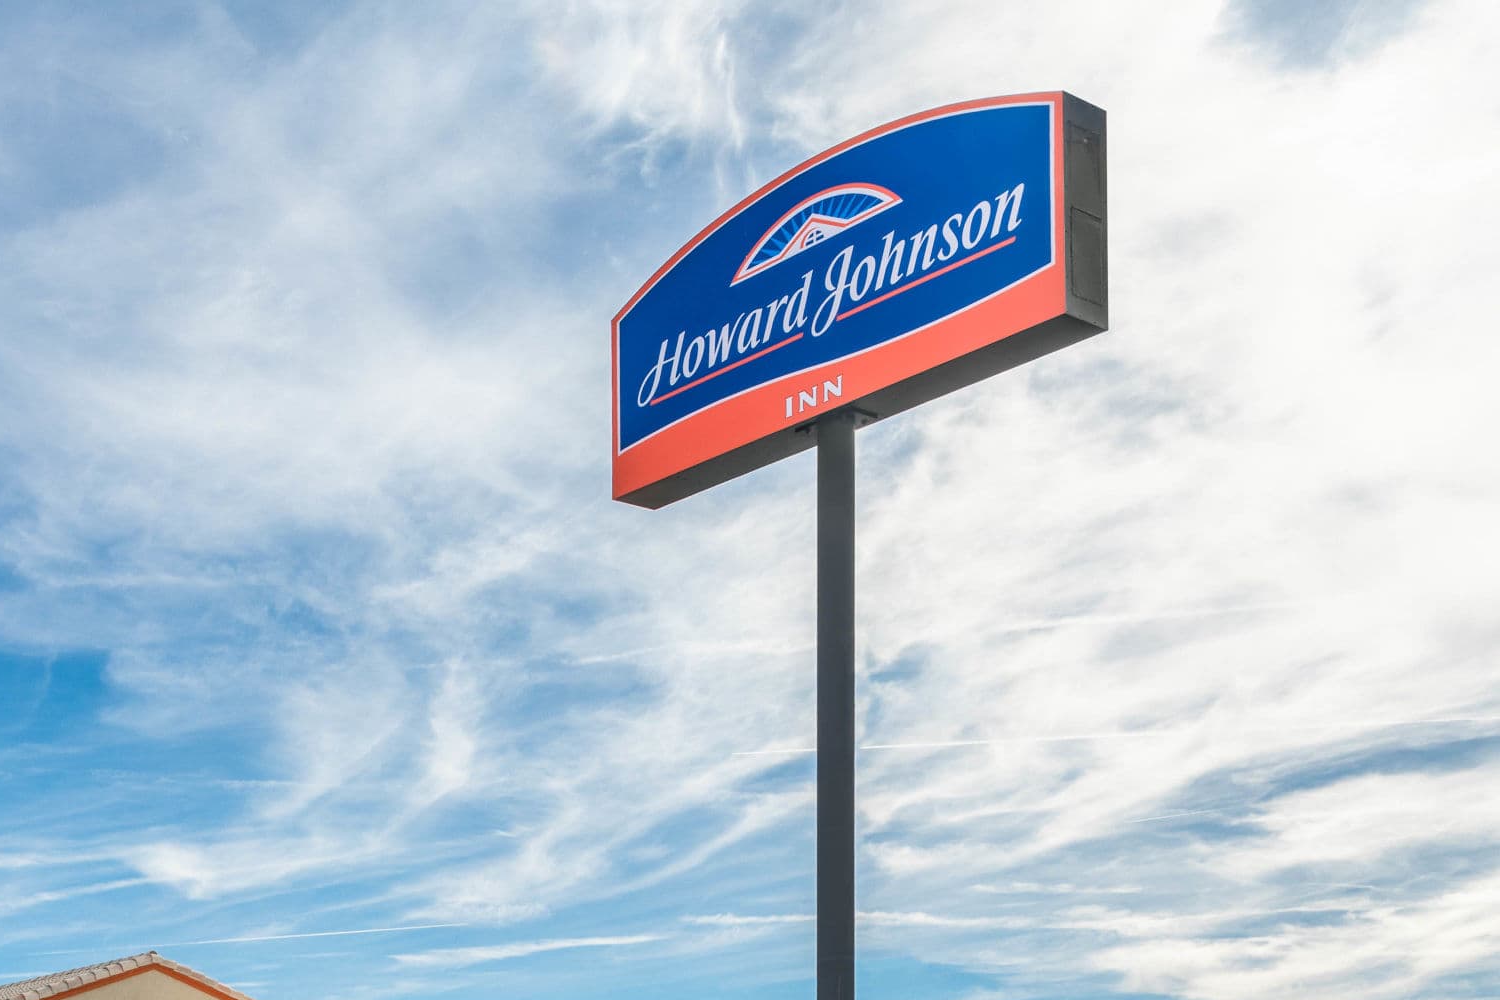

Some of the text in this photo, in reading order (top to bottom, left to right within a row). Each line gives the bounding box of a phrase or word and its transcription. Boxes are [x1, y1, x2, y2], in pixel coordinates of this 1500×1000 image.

[638, 183, 1025, 407] Howard Johnson
[785, 374, 843, 418] INN
